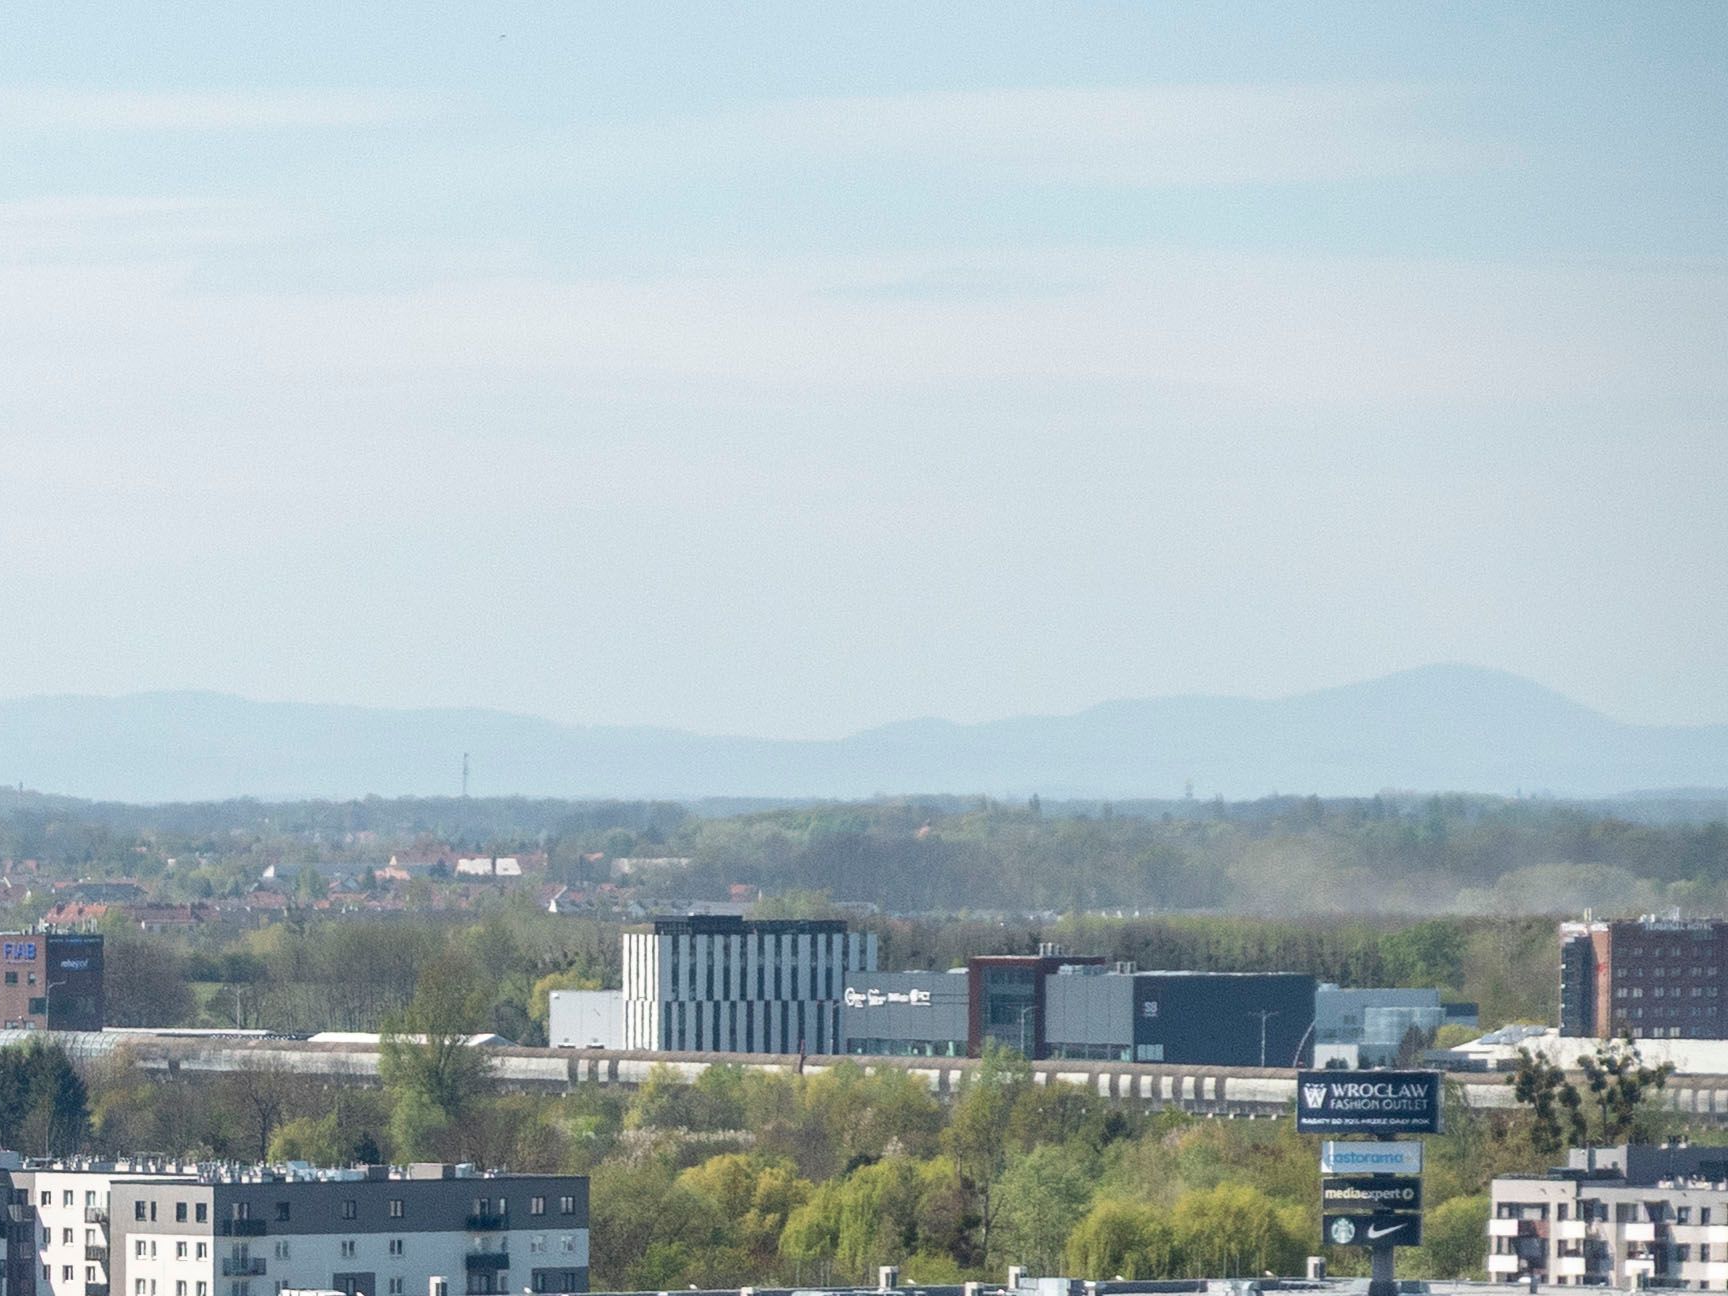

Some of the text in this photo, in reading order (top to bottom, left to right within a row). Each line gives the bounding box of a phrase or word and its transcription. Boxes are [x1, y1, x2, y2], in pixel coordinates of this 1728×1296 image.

[1331, 1083, 1429, 1098] WROCŁAW
[1330, 1099, 1428, 1111] FASHION OUTLET
